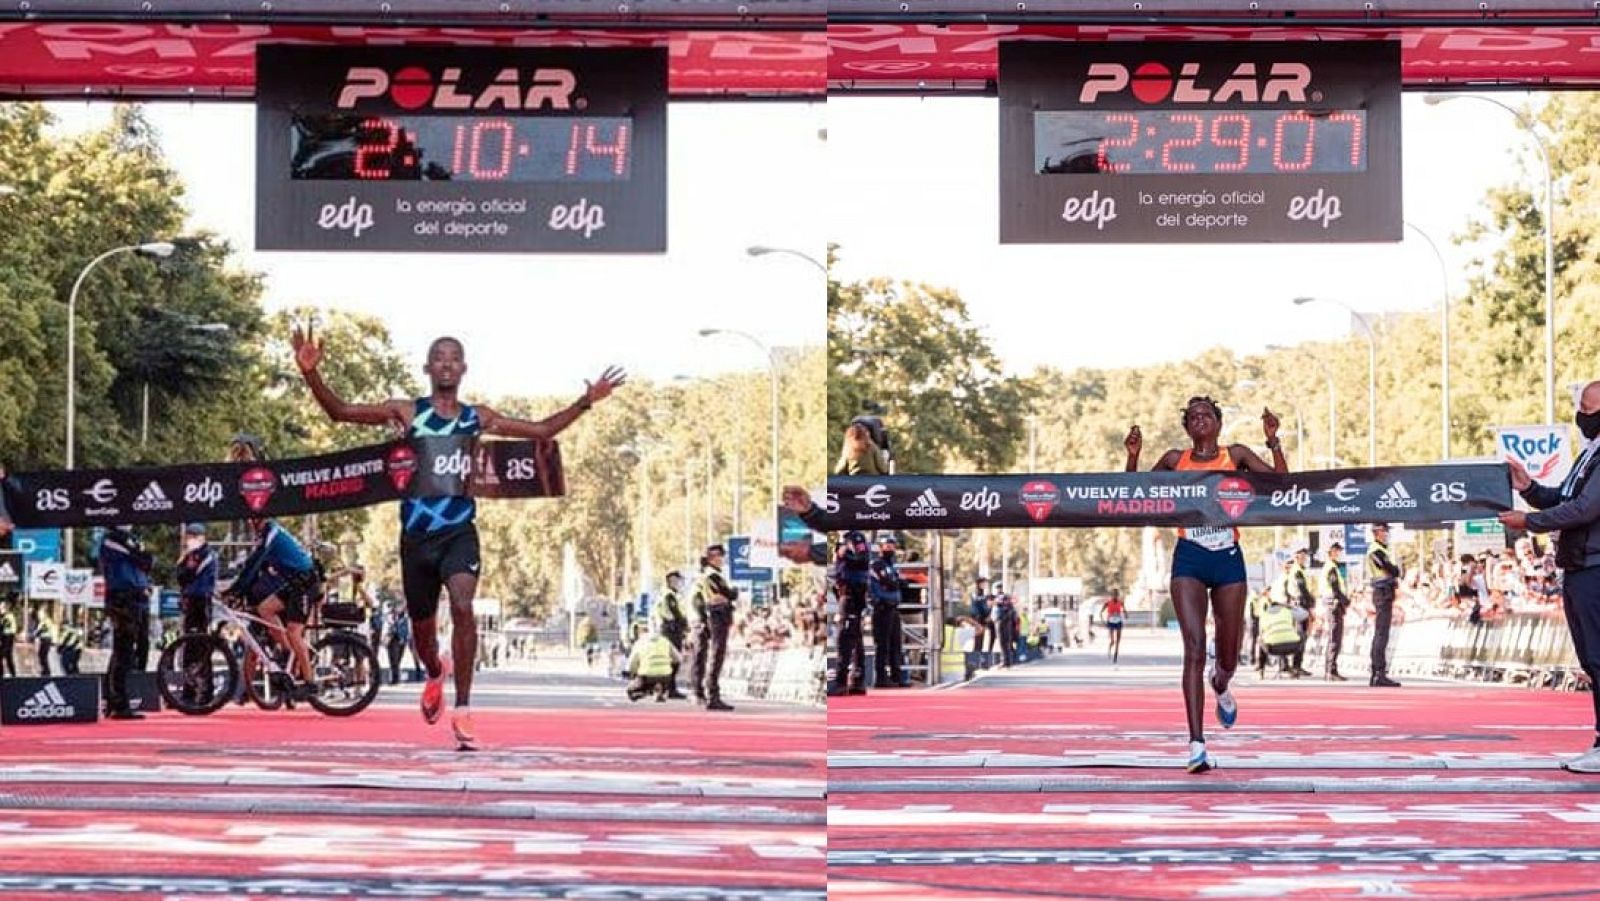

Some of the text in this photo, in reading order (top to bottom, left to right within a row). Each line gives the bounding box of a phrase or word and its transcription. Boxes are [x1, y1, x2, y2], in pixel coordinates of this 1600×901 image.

[337, 66, 576, 109] POLAR
[1079, 61, 1311, 103] POLAR
[396, 199, 411, 213] la
[481, 198, 526, 213] oficial
[1062, 190, 1117, 230] edp
[1138, 190, 1153, 205] la
[1221, 190, 1264, 206] oficial
[1287, 188, 1342, 229] edp
[318, 197, 375, 238] edp
[414, 220, 508, 239] del deporte
[548, 198, 606, 239] edp
[1156, 212, 1248, 230] del deporte
[1501, 432, 1561, 460] Rock
[280, 467, 331, 487] VUELVE
[332, 466, 342, 480] A
[432, 447, 472, 482] edp
[505, 457, 536, 481] as
[36, 487, 71, 511] as
[184, 476, 224, 508] edp
[960, 485, 1001, 518] edp
[1066, 486, 1130, 499] VUELVE
[1133, 486, 1145, 499] A
[1148, 484, 1208, 499] SENTIR
[1270, 483, 1312, 512] edp
[1429, 481, 1468, 503] as
[905, 506, 948, 518] adidas
[1096, 499, 1177, 515] MADRID
[1375, 498, 1418, 510] adidas
[16, 704, 75, 719] adidas
